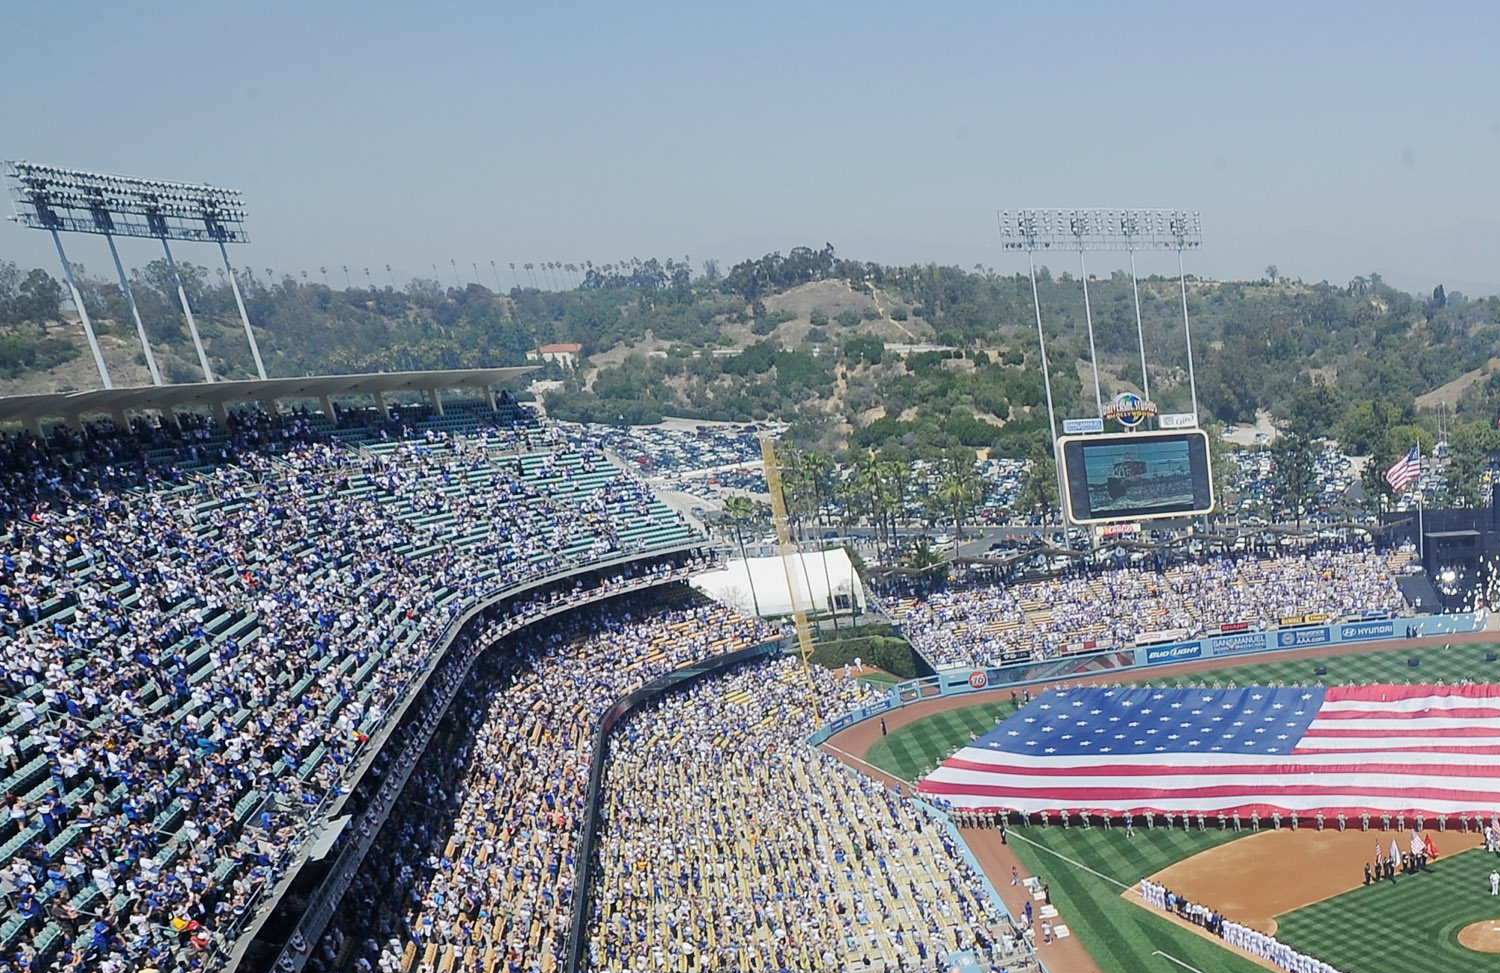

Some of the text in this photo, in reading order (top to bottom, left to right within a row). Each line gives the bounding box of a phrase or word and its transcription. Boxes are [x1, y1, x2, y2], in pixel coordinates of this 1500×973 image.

[1102, 399, 1158, 416] UNIVERSAL STUDIOS
[1295, 628, 1326, 638] Insurance
[1357, 624, 1393, 636] HYUNDAI
[1213, 640, 1227, 648] SAN
[1234, 634, 1266, 647] MANUEL
[1295, 635, 1326, 645] AAA.com
[1149, 646, 1200, 660] BUD LIGHT
[971, 674, 985, 685] 76
